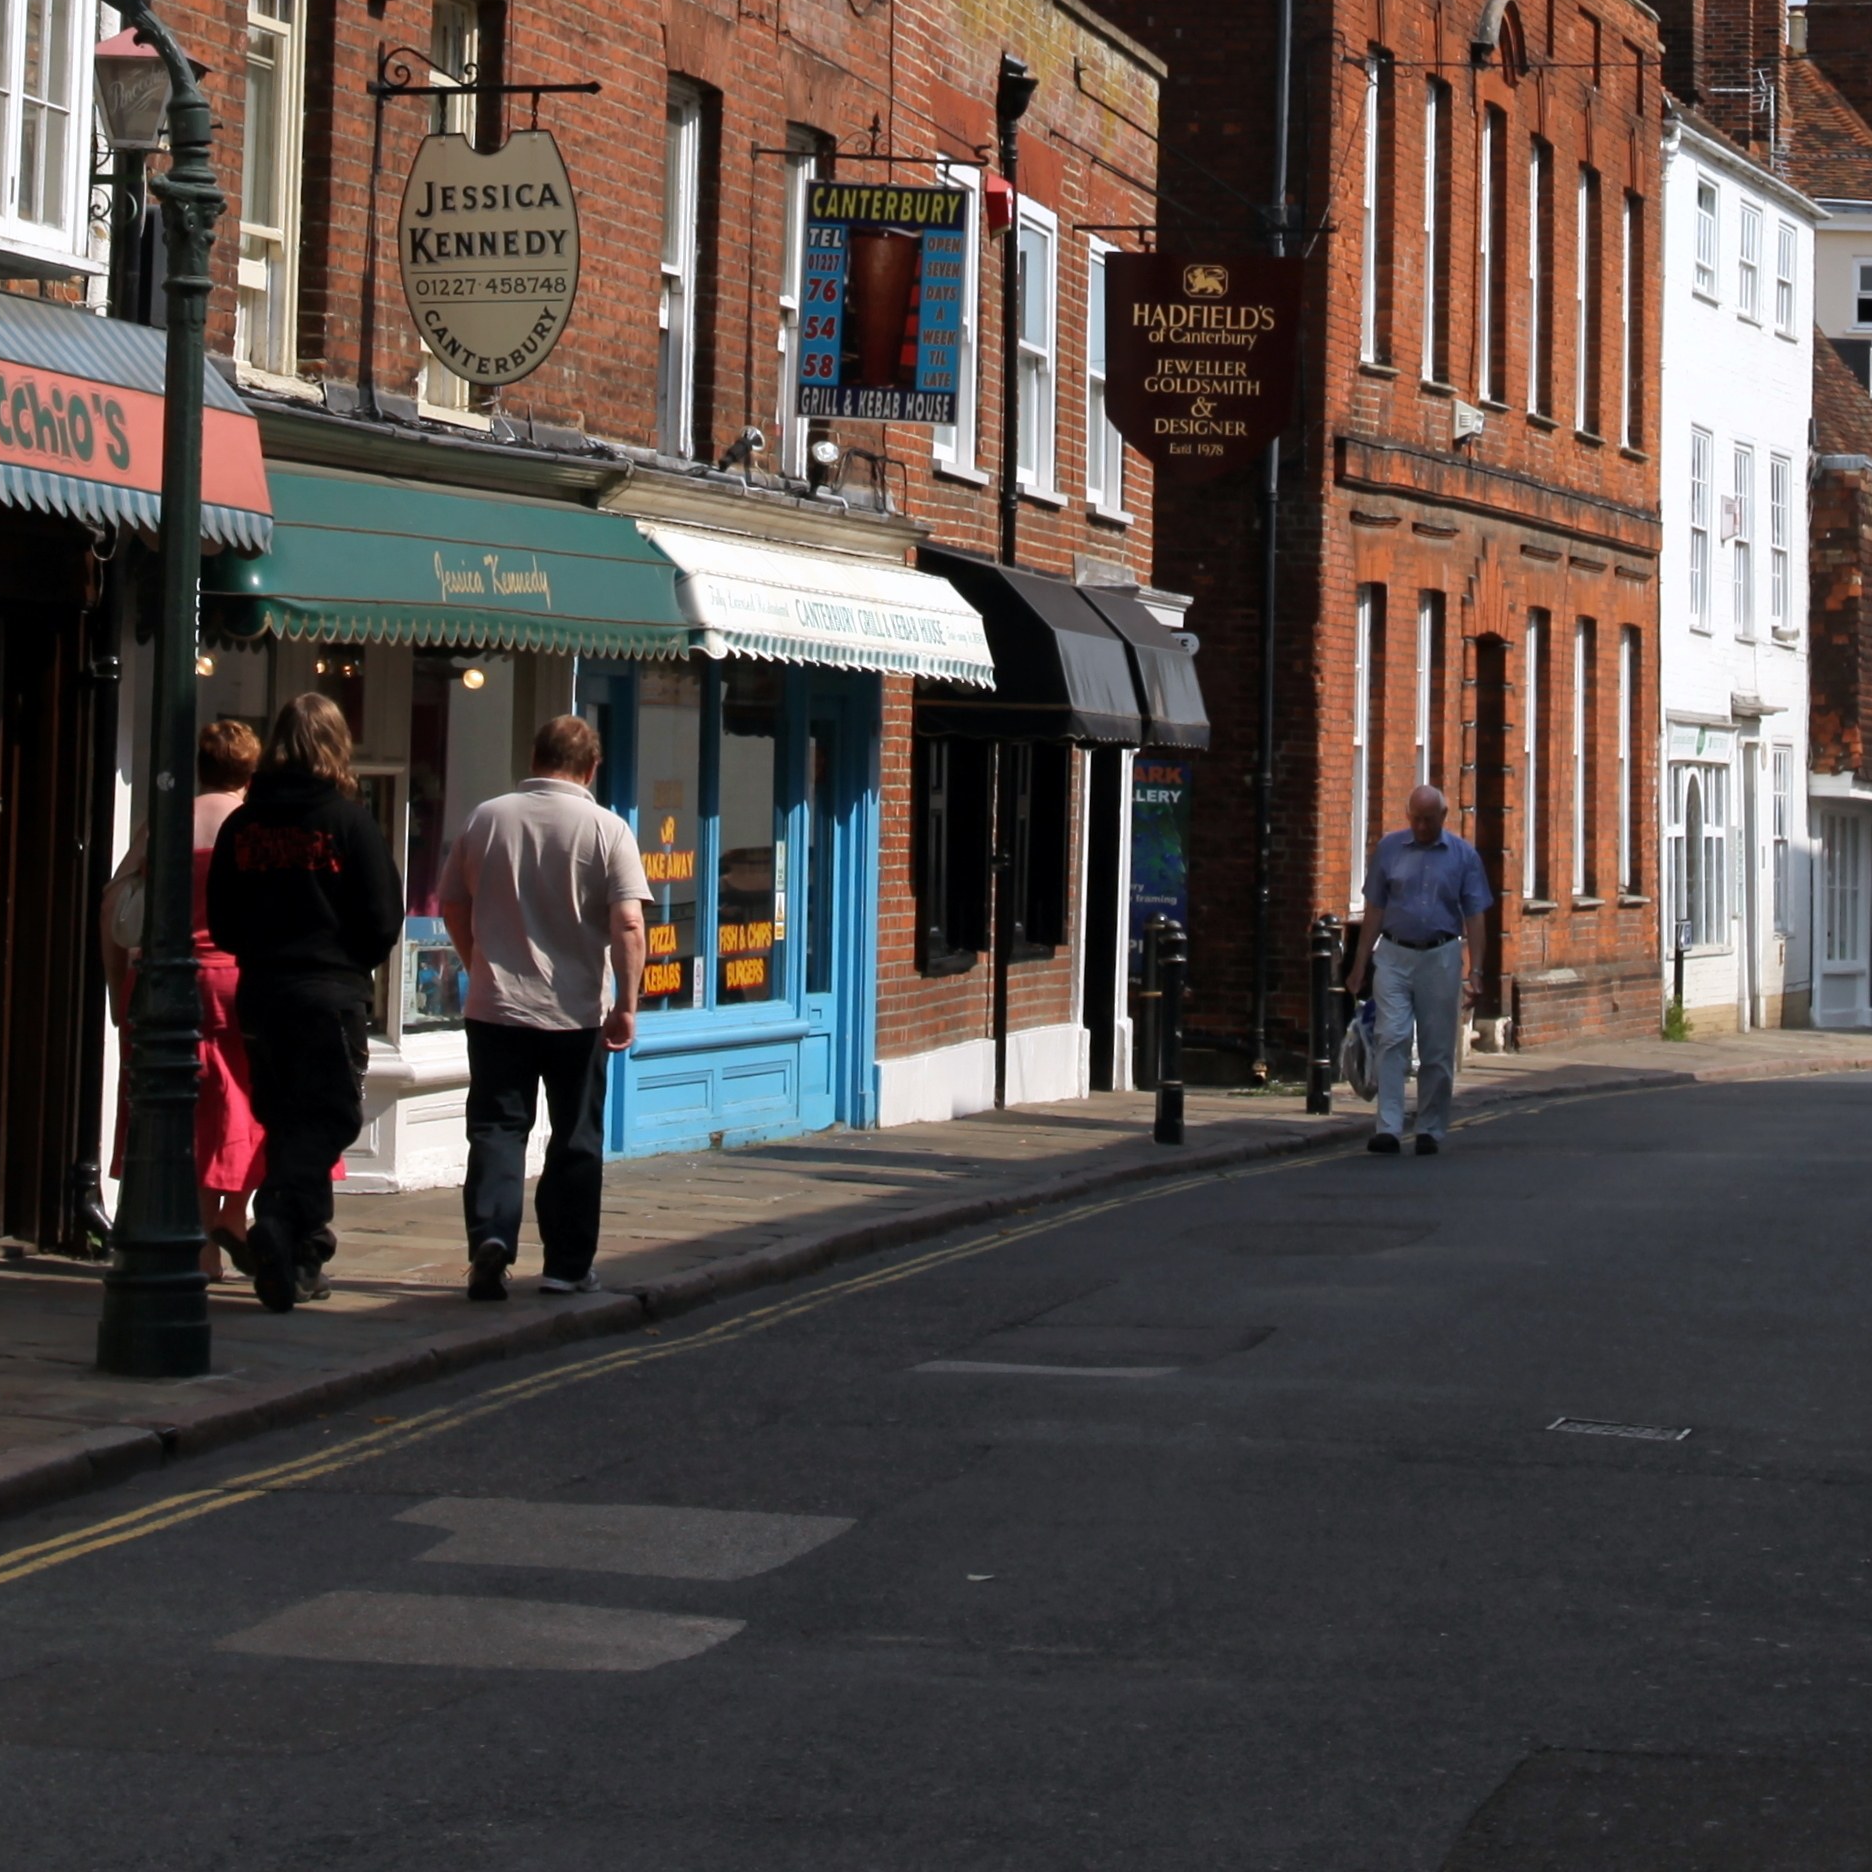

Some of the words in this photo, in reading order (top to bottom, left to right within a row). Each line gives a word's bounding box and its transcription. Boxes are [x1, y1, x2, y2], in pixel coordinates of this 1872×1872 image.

[416, 181, 561, 218] JESSICA
[811, 186, 963, 225] CANTERBURY
[409, 228, 568, 265] KENNEDY
[808, 228, 844, 248] TEL
[927, 237, 962, 254] OPEN
[807, 253, 840, 272] 01227
[926, 261, 961, 278] SEVEN
[806, 277, 838, 302] 76
[924, 285, 958, 302] DAYS
[935, 306, 945, 322] A
[1133, 302, 1275, 330] HADFIELD'S
[804, 314, 836, 340] 54
[922, 329, 956, 347] WEEK
[1148, 327, 1164, 344] of
[1168, 328, 1257, 351] Canterbury
[424, 306, 559, 377] CANTERBURY
[802, 353, 834, 378] 58
[929, 350, 947, 366] TIL
[1155, 358, 1248, 377] JEWELLER
[922, 371, 951, 389] LATE
[1144, 376, 1261, 397] GOLDSMITH
[801, 387, 839, 415] GRILL
[842, 391, 854, 415] &
[857, 392, 901, 418] KEBAB
[905, 394, 950, 422] HOUSE
[1190, 395, 1218, 418] &
[1154, 418, 1248, 437] DESIGNER
[1197, 443, 1224, 457] 1978
[434, 551, 485, 602] Jessica
[485, 555, 552, 609] Kennedy
[795, 598, 857, 633] CANTERBURY
[858, 608, 885, 638] GRILL
[889, 613, 919, 642] KEBAB
[918, 617, 947, 646] HOUSE
[661, 816, 675, 844] OR
[668, 850, 695, 879] AWAY
[1136, 894, 1178, 907] framing
[649, 924, 677, 954] PIZZA
[719, 924, 739, 953] FISH
[739, 924, 748, 951] &
[748, 921, 773, 949] CHIPS
[643, 962, 681, 994] KEBABS
[726, 958, 765, 987] BURGERS
